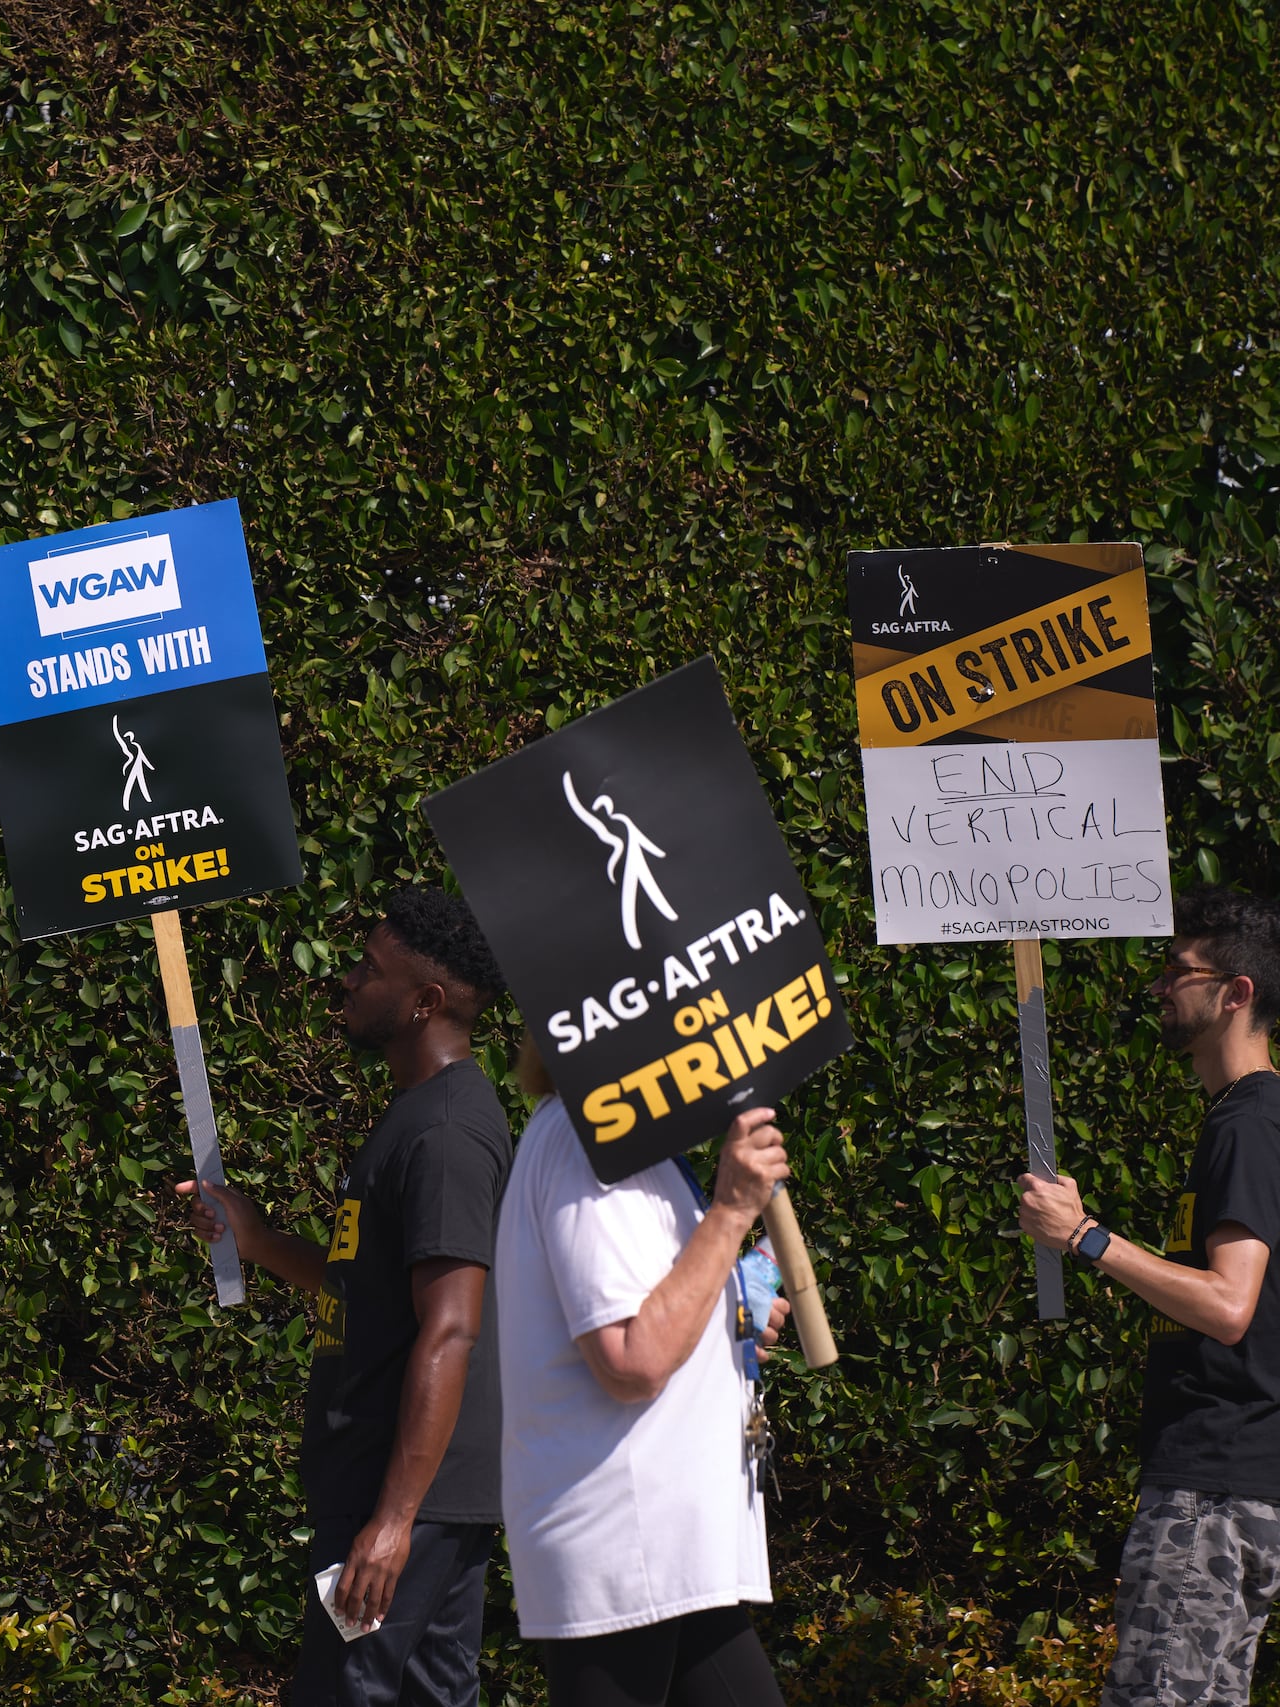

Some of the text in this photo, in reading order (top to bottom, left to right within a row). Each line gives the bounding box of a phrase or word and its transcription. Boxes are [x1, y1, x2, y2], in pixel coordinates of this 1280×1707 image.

[38, 559, 167, 609] WGAW
[26, 626, 212, 698] STANDS WITH
[881, 594, 1131, 734] ON STRIKE
[931, 750, 1065, 797] END
[891, 797, 1162, 846] VERTICAL
[81, 847, 231, 904] STRIKE!
[134, 842, 166, 861] ON
[880, 859, 1162, 909] MONOPOLIES
[673, 989, 730, 1037] ON
[582, 963, 832, 1144] STRIKE!
